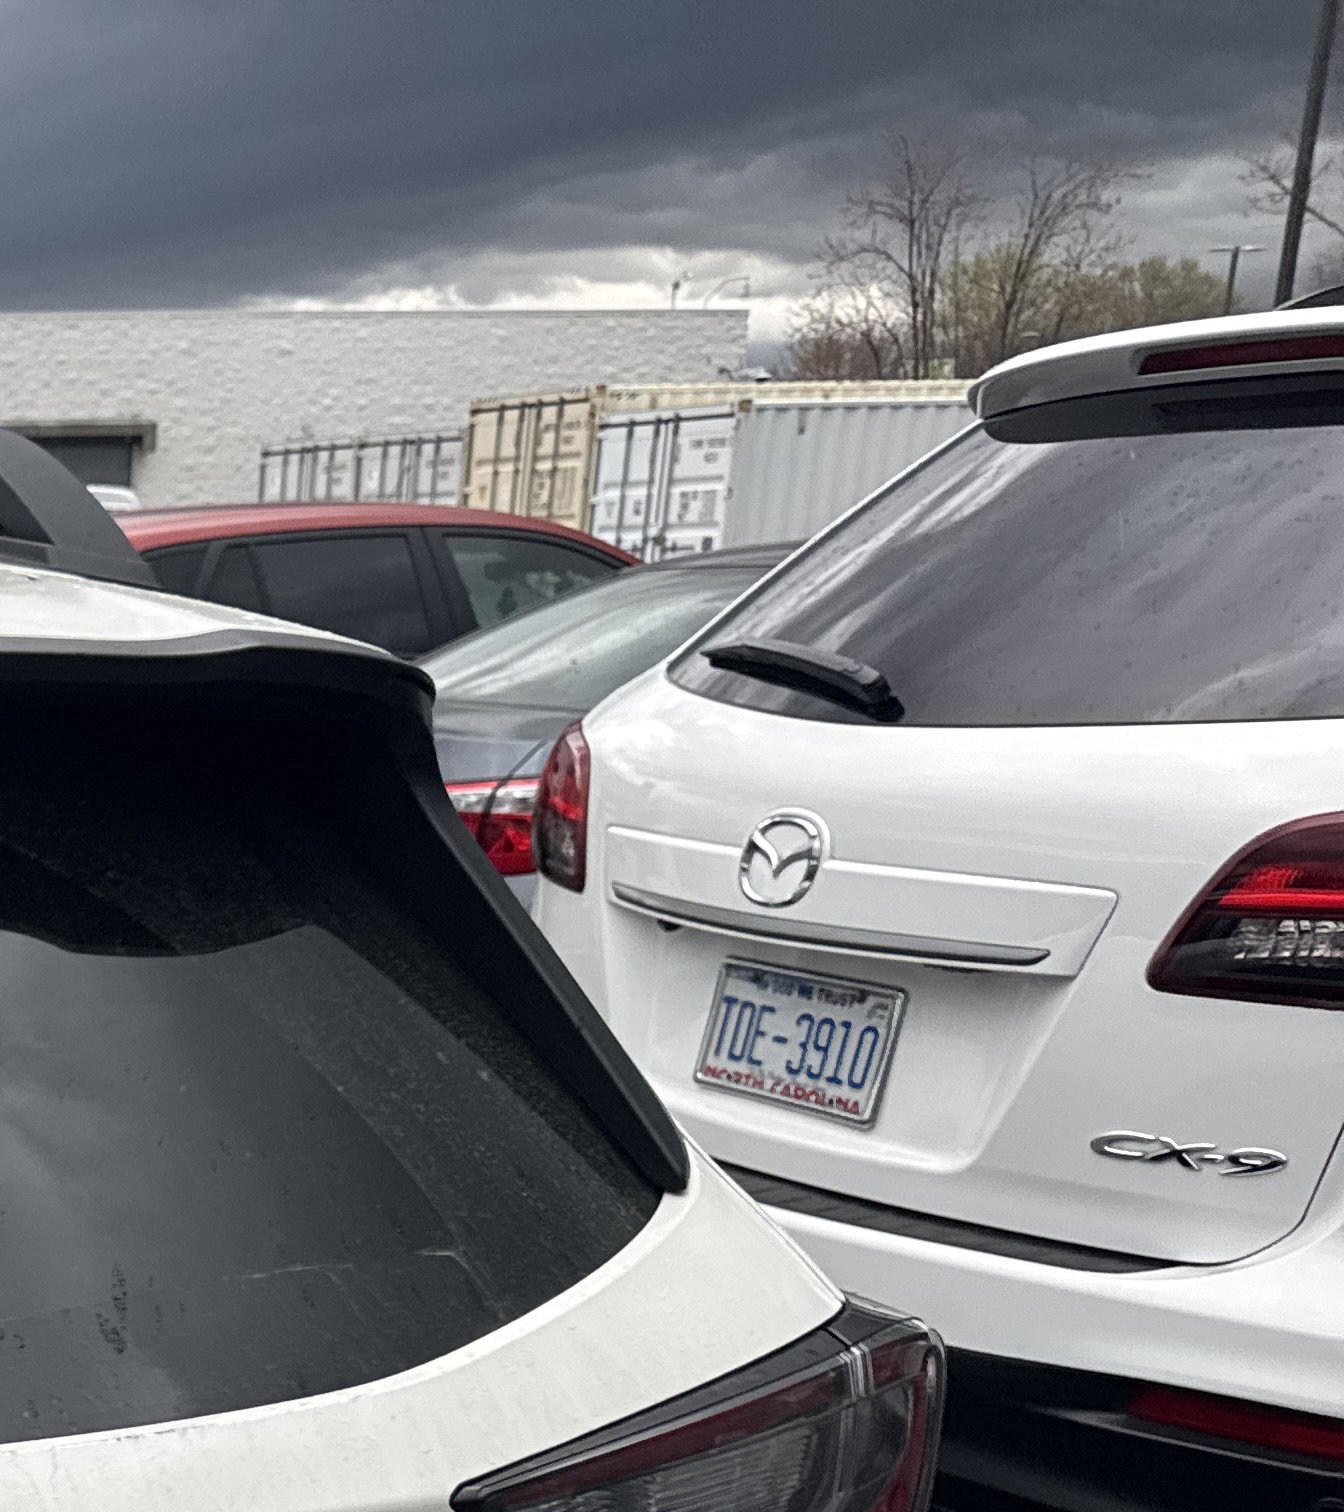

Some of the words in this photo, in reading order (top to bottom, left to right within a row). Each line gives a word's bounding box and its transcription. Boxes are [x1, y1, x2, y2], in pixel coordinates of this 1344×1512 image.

[714, 996, 881, 1090] TDE-3910
[769, 1079, 861, 1115] CAROLNA
[1090, 1130, 1288, 1178] CX-9
